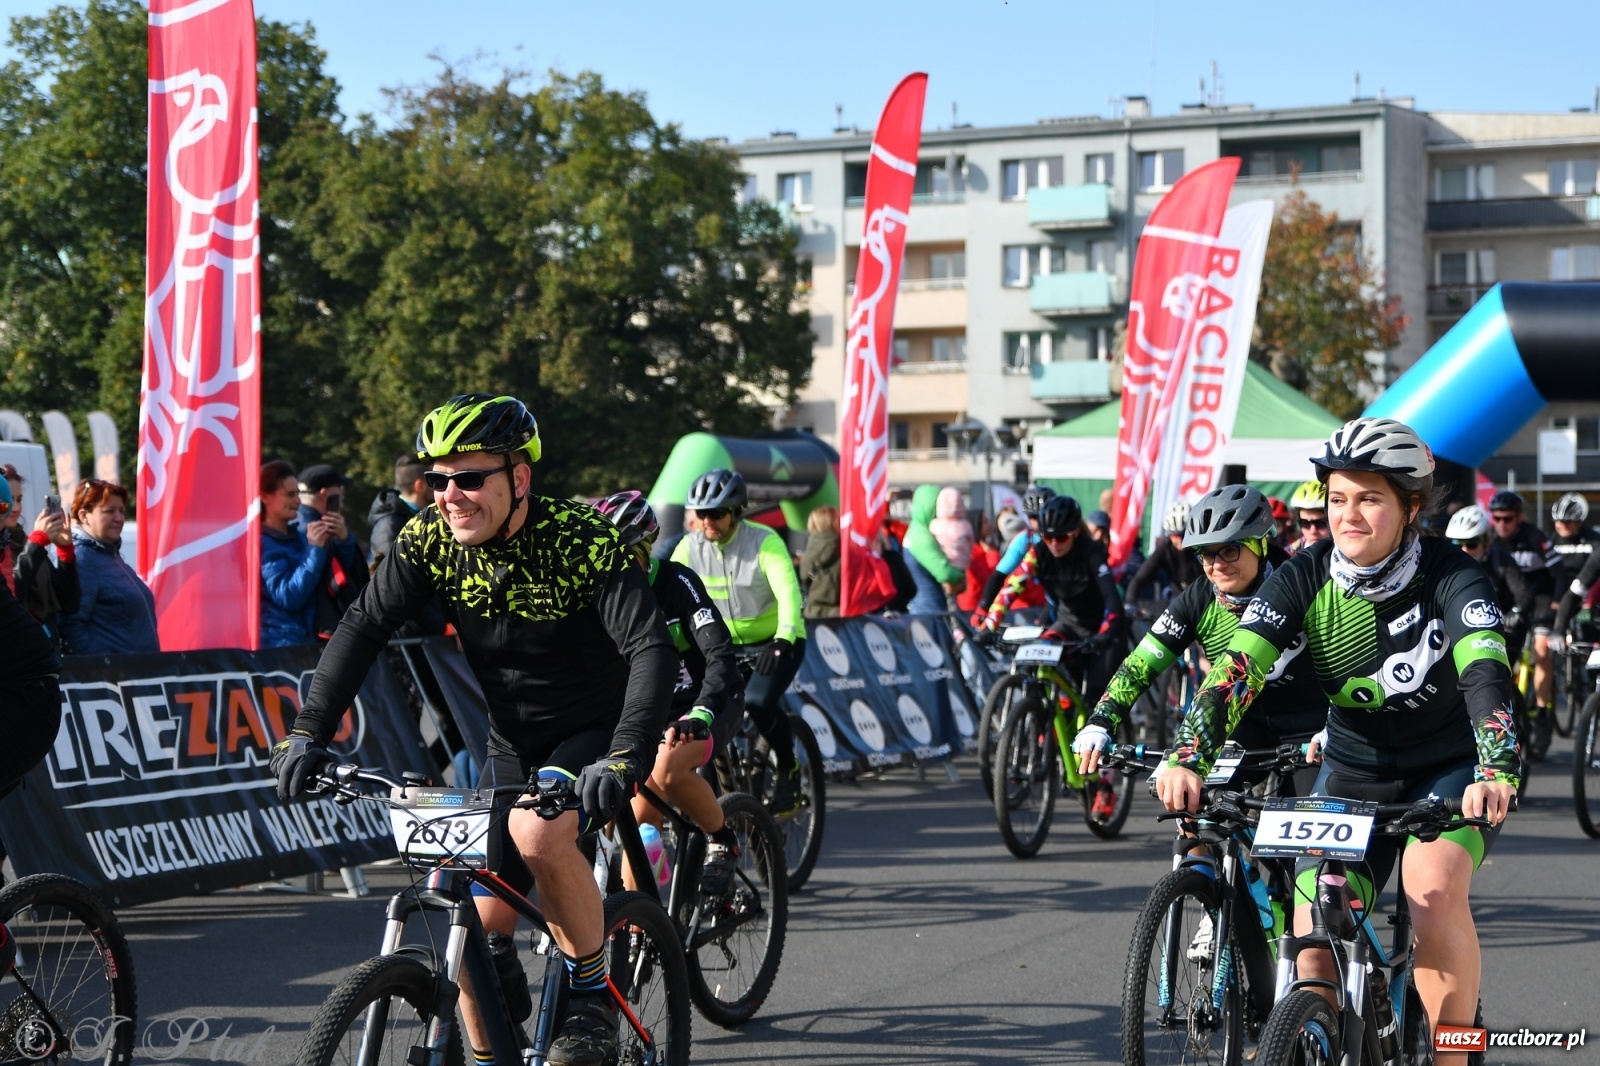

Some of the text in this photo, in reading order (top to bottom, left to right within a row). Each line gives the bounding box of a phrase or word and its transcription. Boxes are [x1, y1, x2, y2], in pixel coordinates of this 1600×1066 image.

[1179, 246, 1242, 497] RACIBÓR
[457, 443, 482, 452] uvex
[1251, 601, 1287, 626] kiwi
[1396, 613, 1417, 629] OLKA
[1404, 683, 1438, 709] MTB
[406, 820, 469, 845] 2673
[1278, 821, 1353, 842] 1570
[86, 810, 262, 881] USZCZELNIAMY
